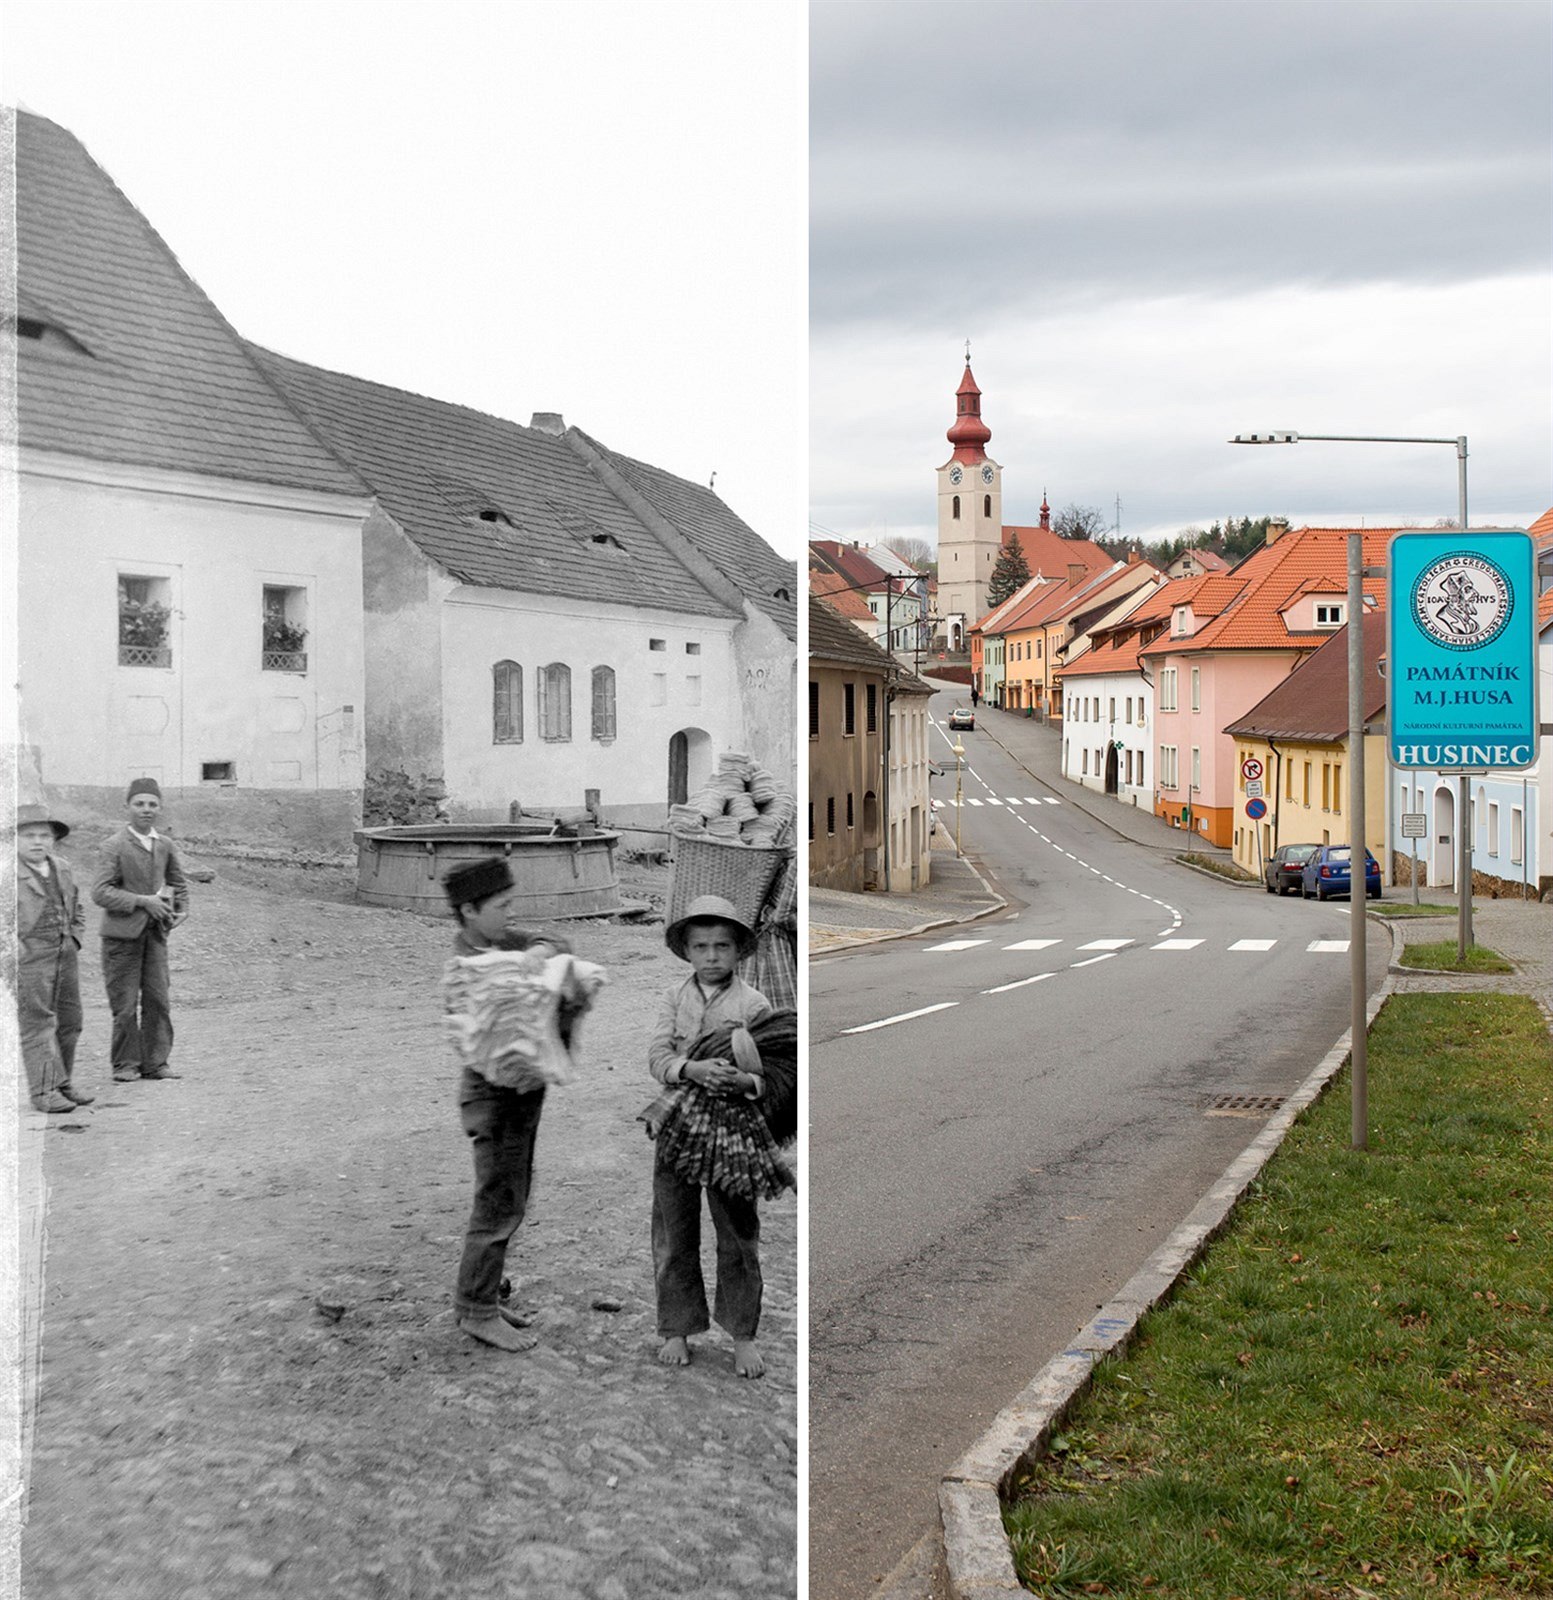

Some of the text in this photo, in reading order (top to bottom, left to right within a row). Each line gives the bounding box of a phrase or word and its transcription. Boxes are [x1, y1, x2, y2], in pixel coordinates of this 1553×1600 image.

[1407, 662, 1520, 681] PAMÁTNÍK
[1413, 689, 1514, 708] M.J.HUSA
[1403, 722, 1523, 730] NÁRODNÍ KULTURNÍ PAMÁTKA
[1397, 744, 1530, 765] HUSINEC
